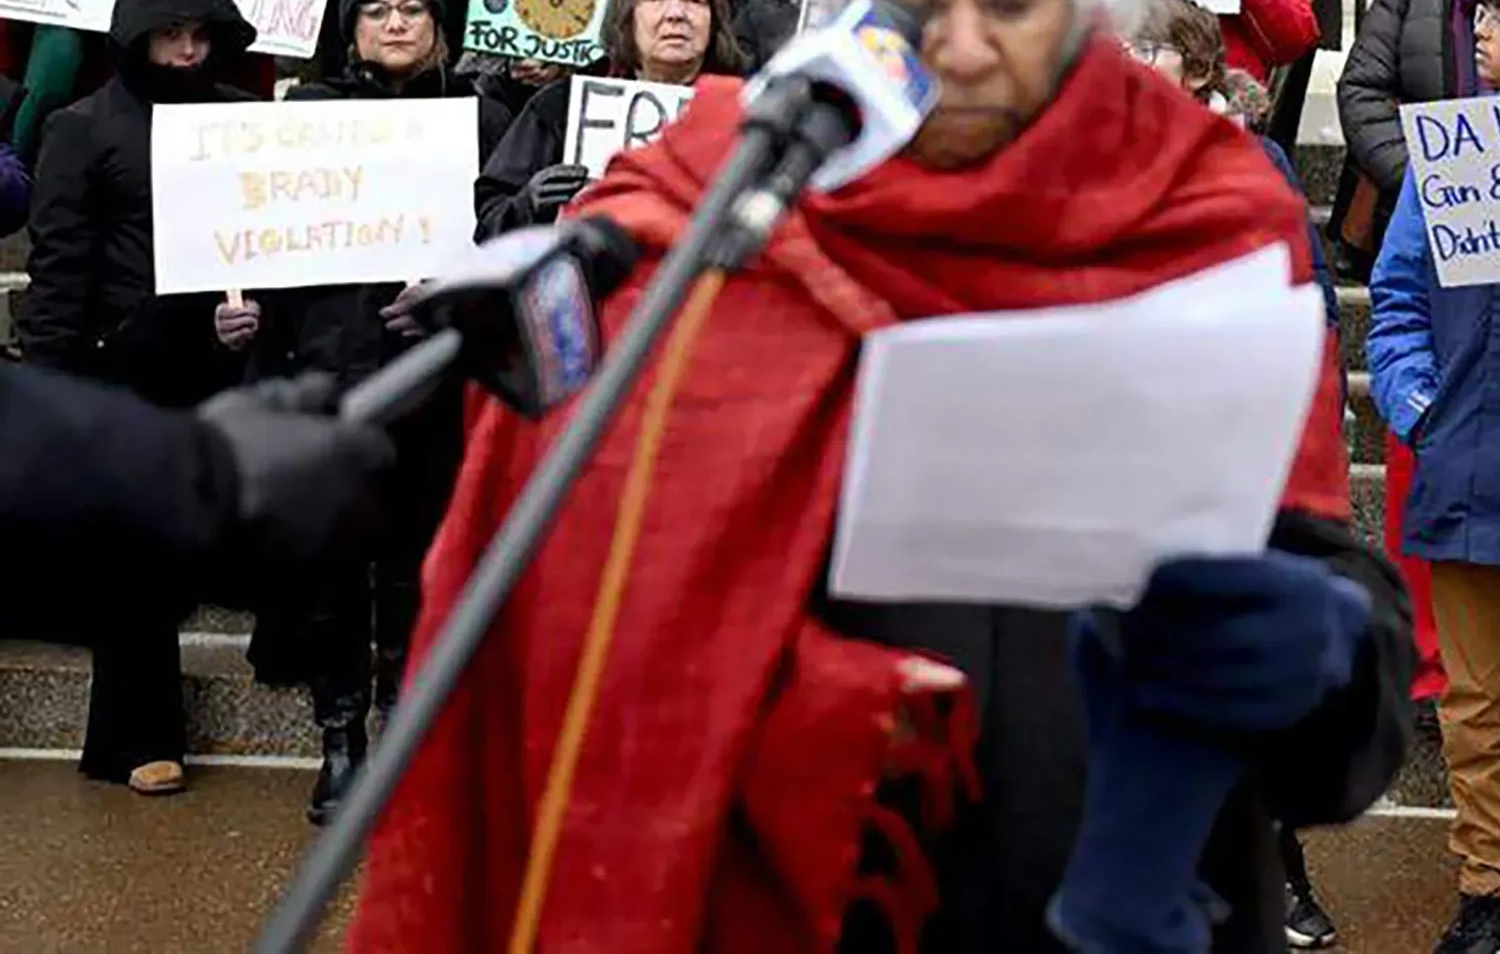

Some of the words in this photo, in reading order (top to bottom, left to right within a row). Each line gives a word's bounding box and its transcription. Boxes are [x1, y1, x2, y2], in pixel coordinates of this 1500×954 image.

[468, 20, 519, 53] FOR
[523, 33, 602, 64] JUSTIC
[574, 80, 692, 165] FR
[1416, 113, 1485, 163] DA
[237, 163, 365, 211] BRADY
[1421, 173, 1481, 208] Gun
